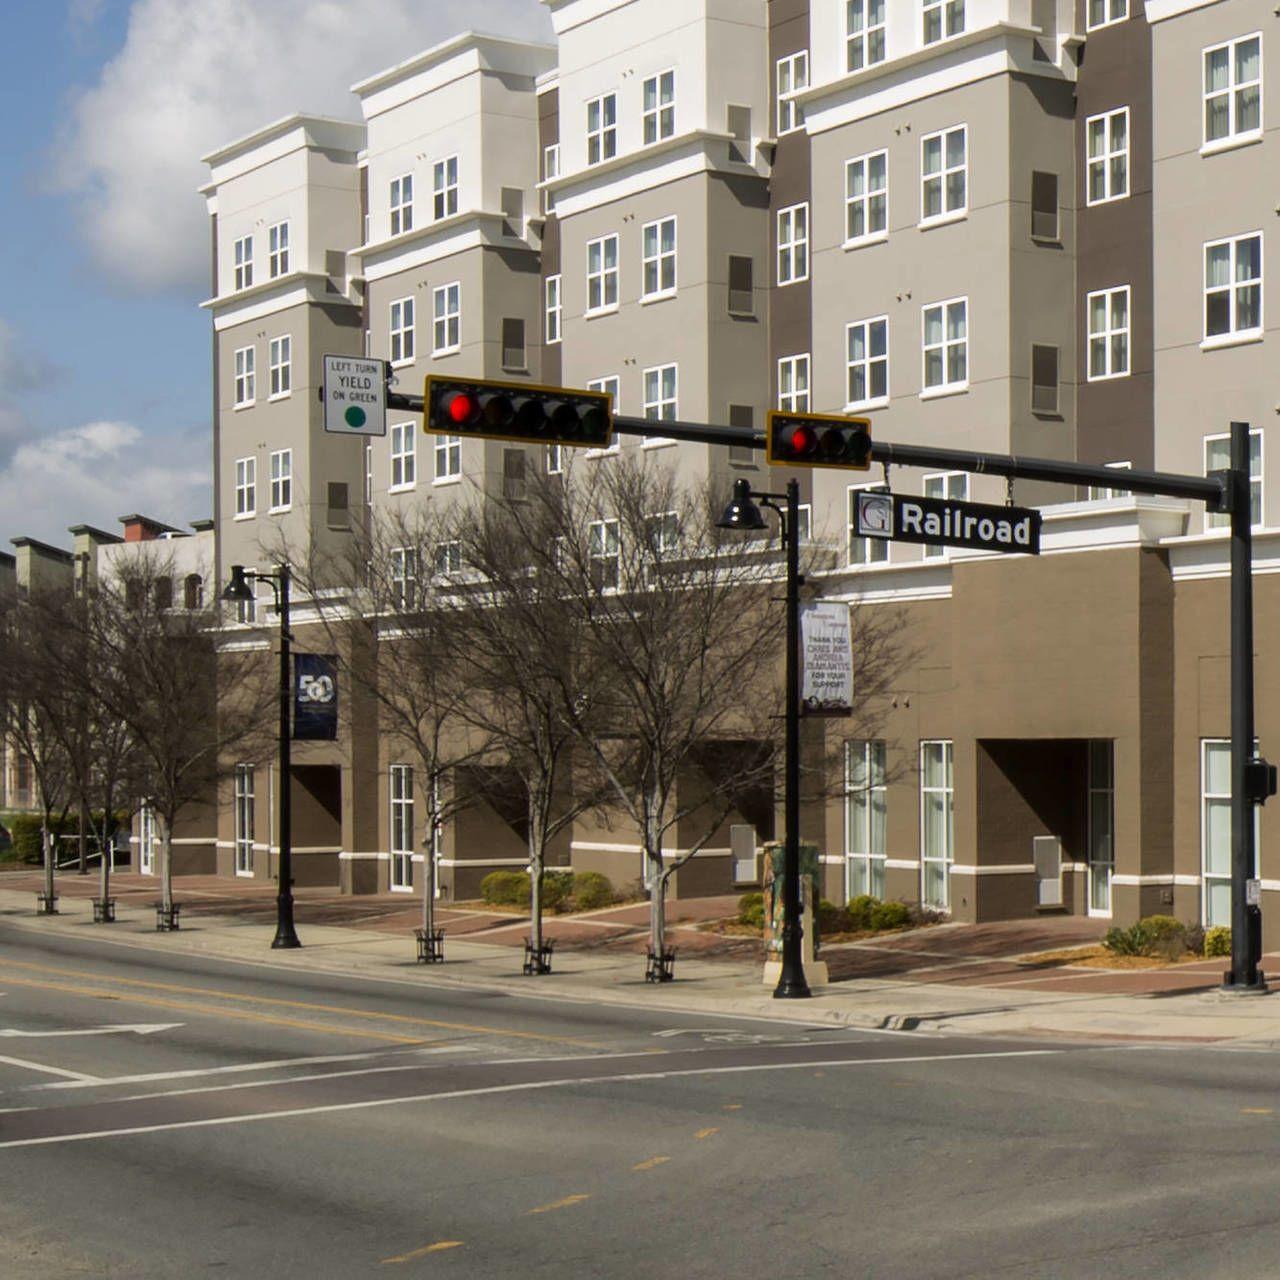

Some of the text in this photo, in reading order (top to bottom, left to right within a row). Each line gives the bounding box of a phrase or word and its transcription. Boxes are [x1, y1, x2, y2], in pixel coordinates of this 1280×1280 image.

[331, 361, 378, 373] LEFT TURN
[339, 375, 371, 389] YIELD
[332, 390, 377, 403] ON GREEN
[902, 503, 1030, 545] Railroad
